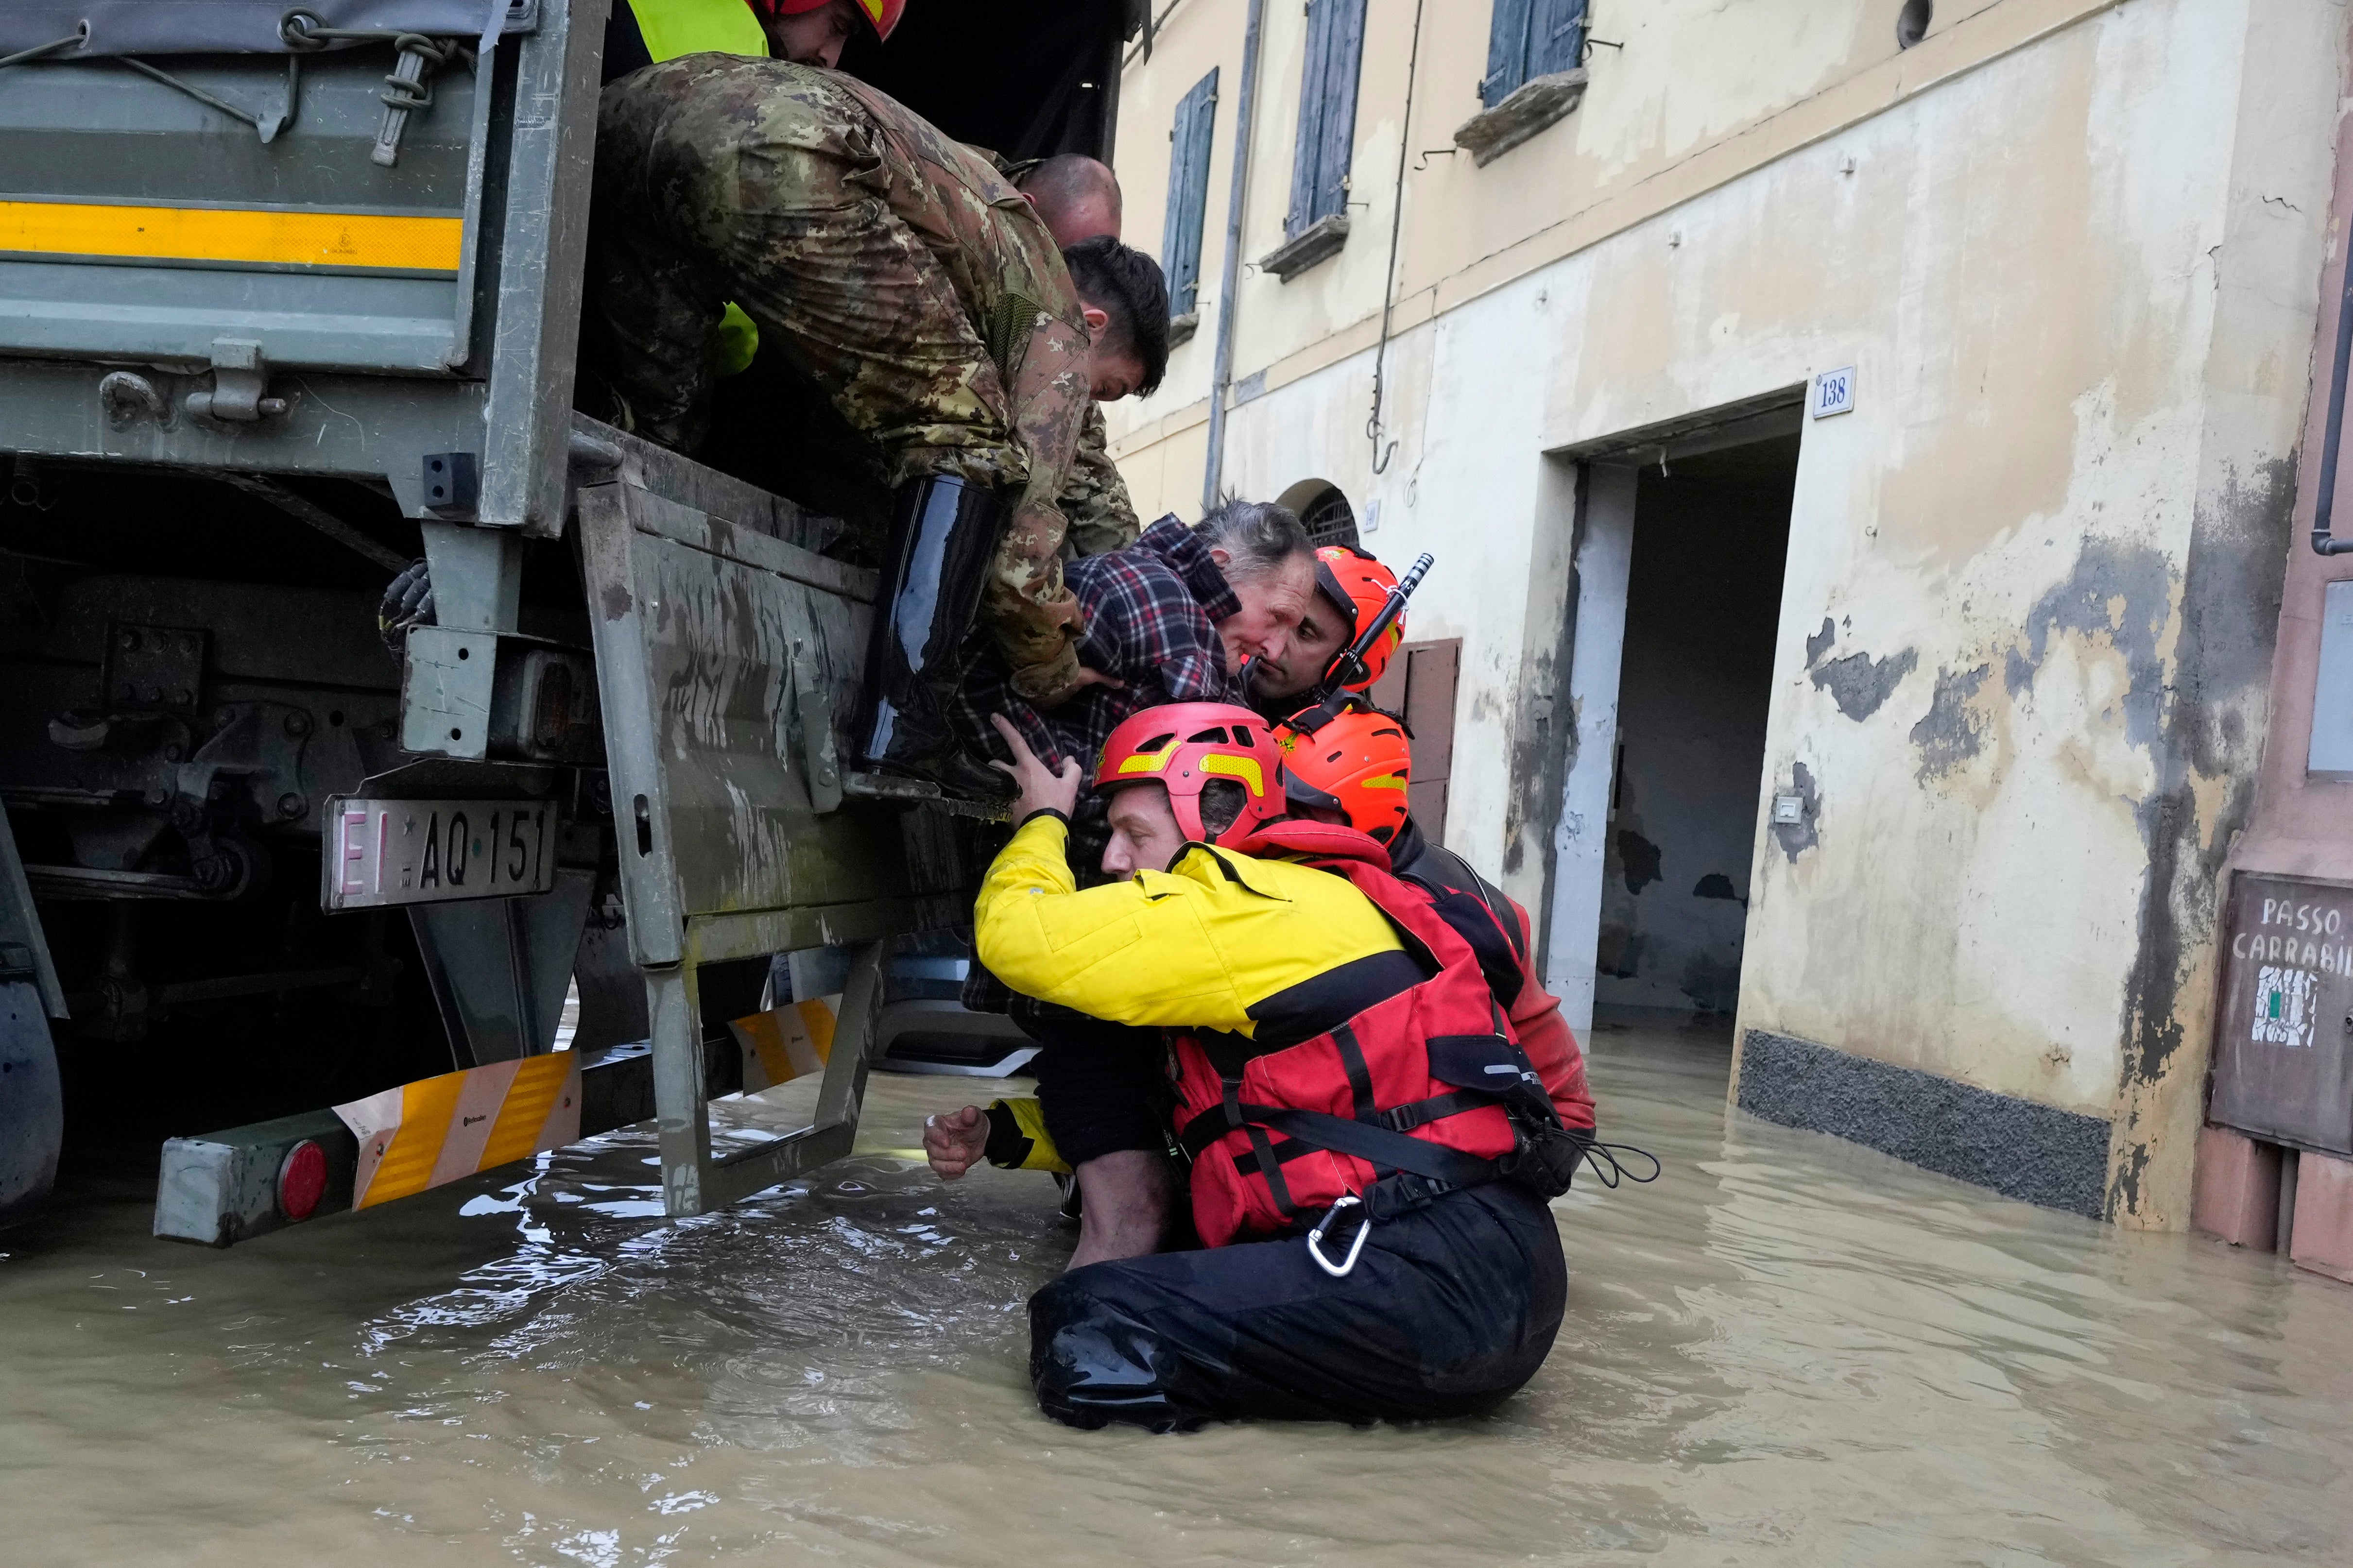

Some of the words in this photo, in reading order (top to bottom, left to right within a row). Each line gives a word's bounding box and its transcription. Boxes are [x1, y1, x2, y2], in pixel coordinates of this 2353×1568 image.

[1821, 377, 1845, 408] 138
[341, 810, 388, 895] EI
[419, 811, 468, 888] AQ
[490, 810, 544, 890] 151
[2261, 898, 2340, 935] PASSO
